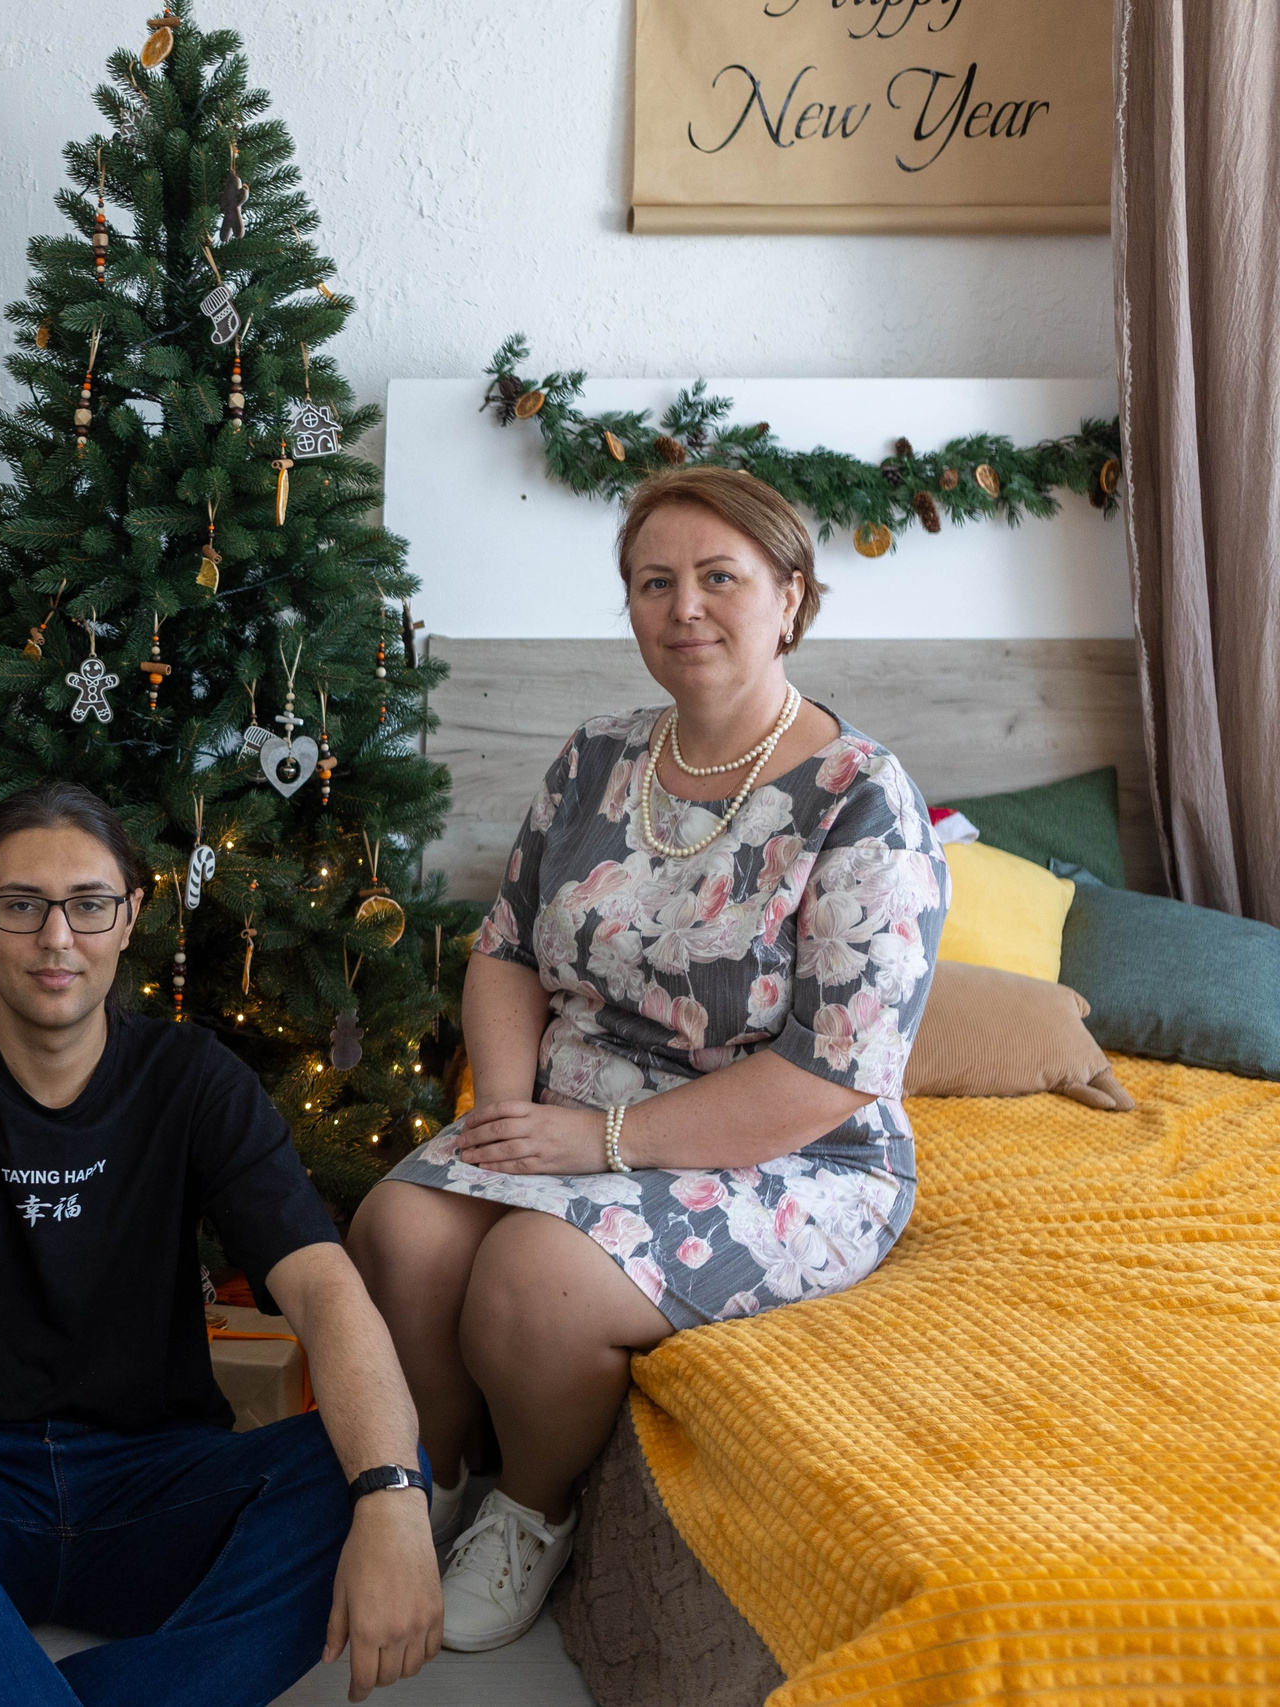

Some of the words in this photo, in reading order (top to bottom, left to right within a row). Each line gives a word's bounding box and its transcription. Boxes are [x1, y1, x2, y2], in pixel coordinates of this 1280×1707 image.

[688, 63, 871, 154] New
[886, 62, 1049, 172] Year
[16, 1193, 82, 1228] 幸福
